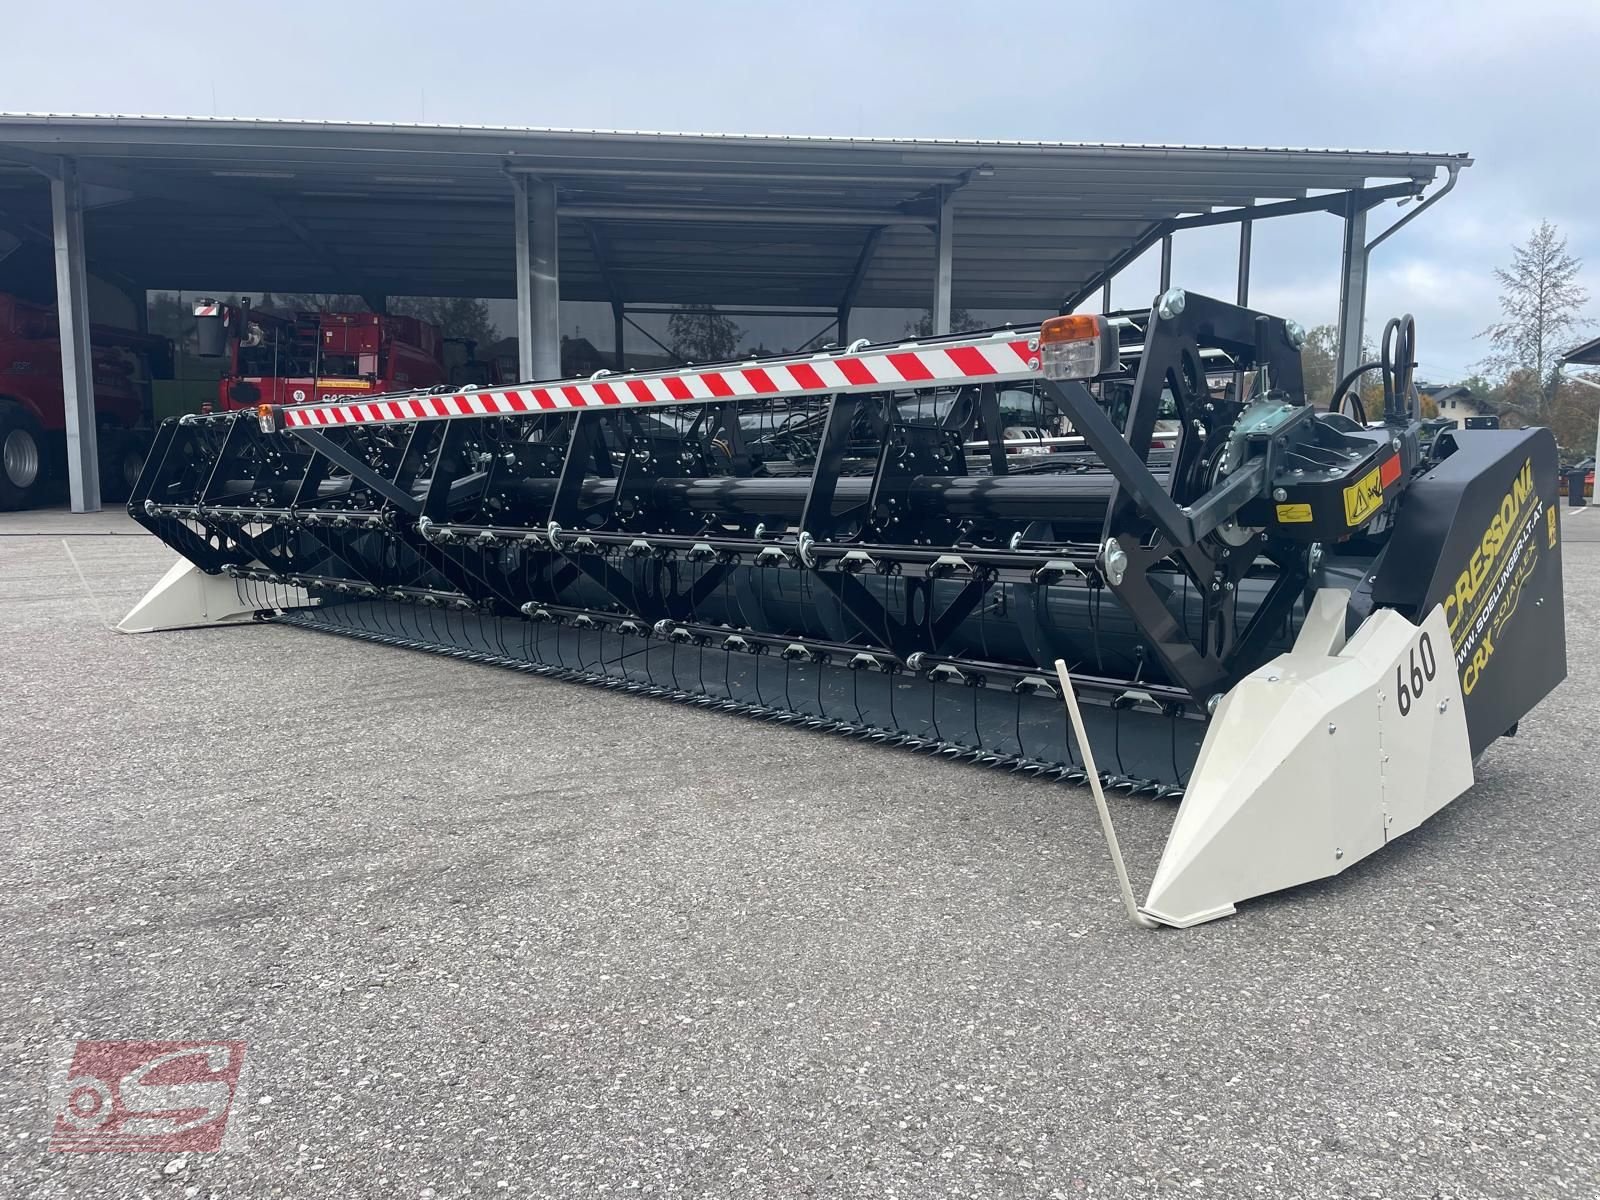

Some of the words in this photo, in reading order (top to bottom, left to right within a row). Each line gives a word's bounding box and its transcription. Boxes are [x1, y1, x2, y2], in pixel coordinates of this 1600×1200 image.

[1397, 632, 1436, 716] 660
[1463, 627, 1495, 695] CRX
[1493, 540, 1537, 629] SOJAFLEX
